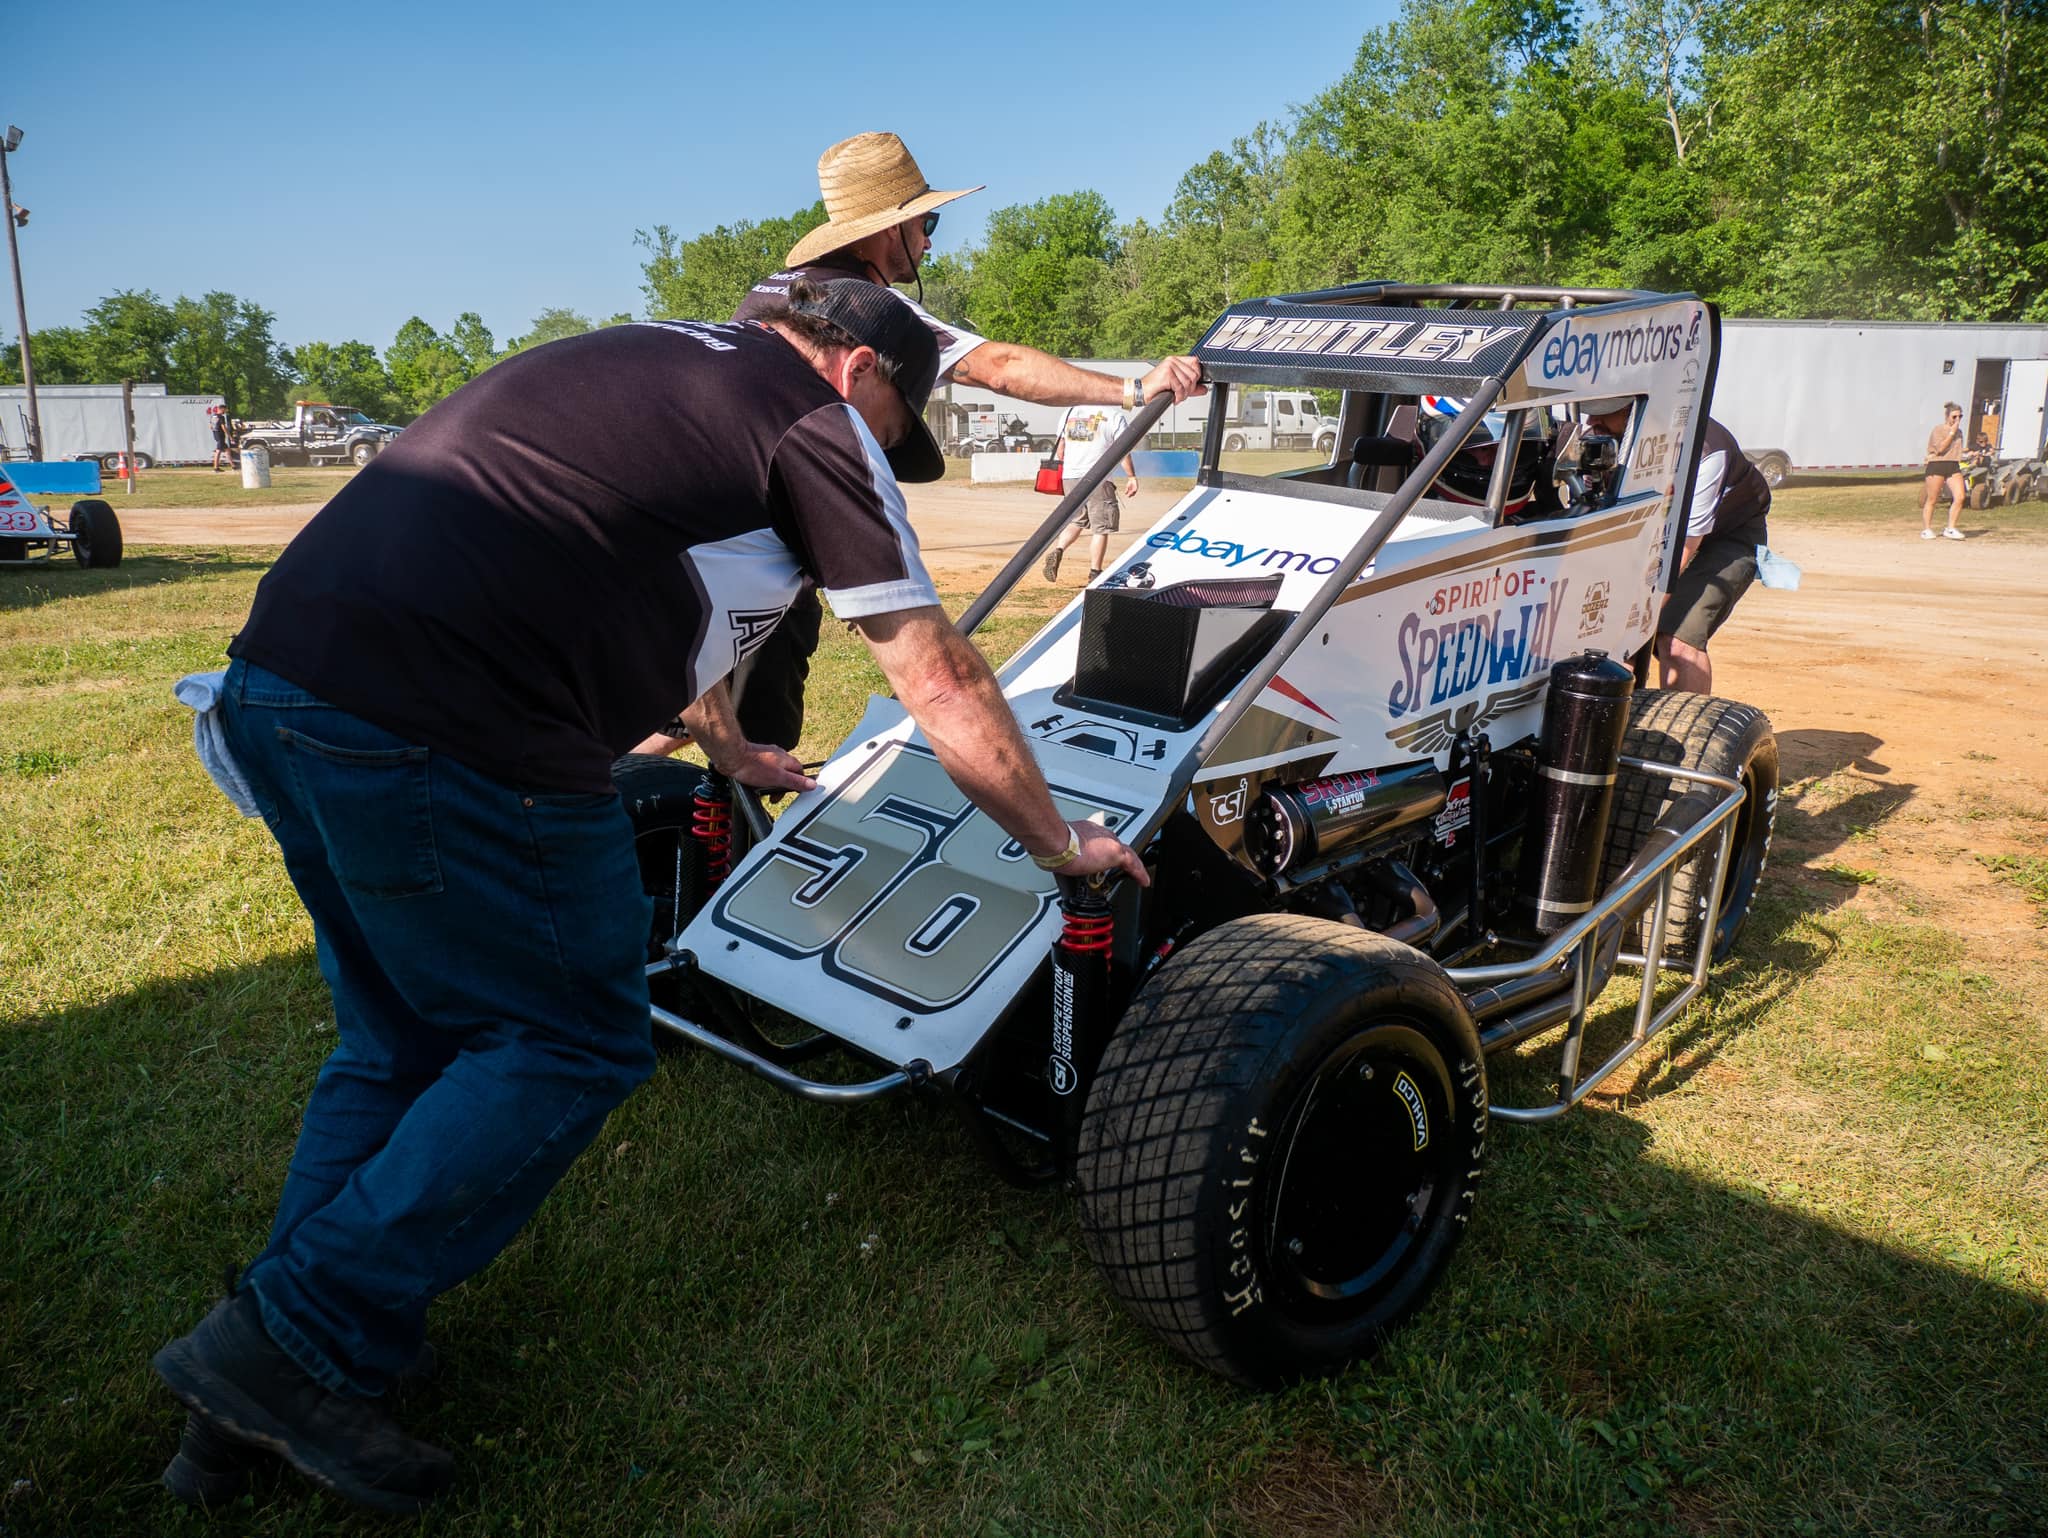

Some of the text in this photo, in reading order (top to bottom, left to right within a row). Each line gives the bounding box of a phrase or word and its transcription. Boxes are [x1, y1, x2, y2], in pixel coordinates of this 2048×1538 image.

[1204, 315, 1524, 362] WHITLEY
[1543, 318, 1682, 384] ebay motors
[1146, 529, 1268, 567] ebay
[1432, 570, 1536, 616] SPIRIT OF
[1389, 578, 1568, 718] SPEEDWAY
[1053, 963, 1063, 1053] COMPETITION
[1062, 985, 1074, 1060] SUSPENSION
[1398, 1079, 1425, 1145] VAHLCO
